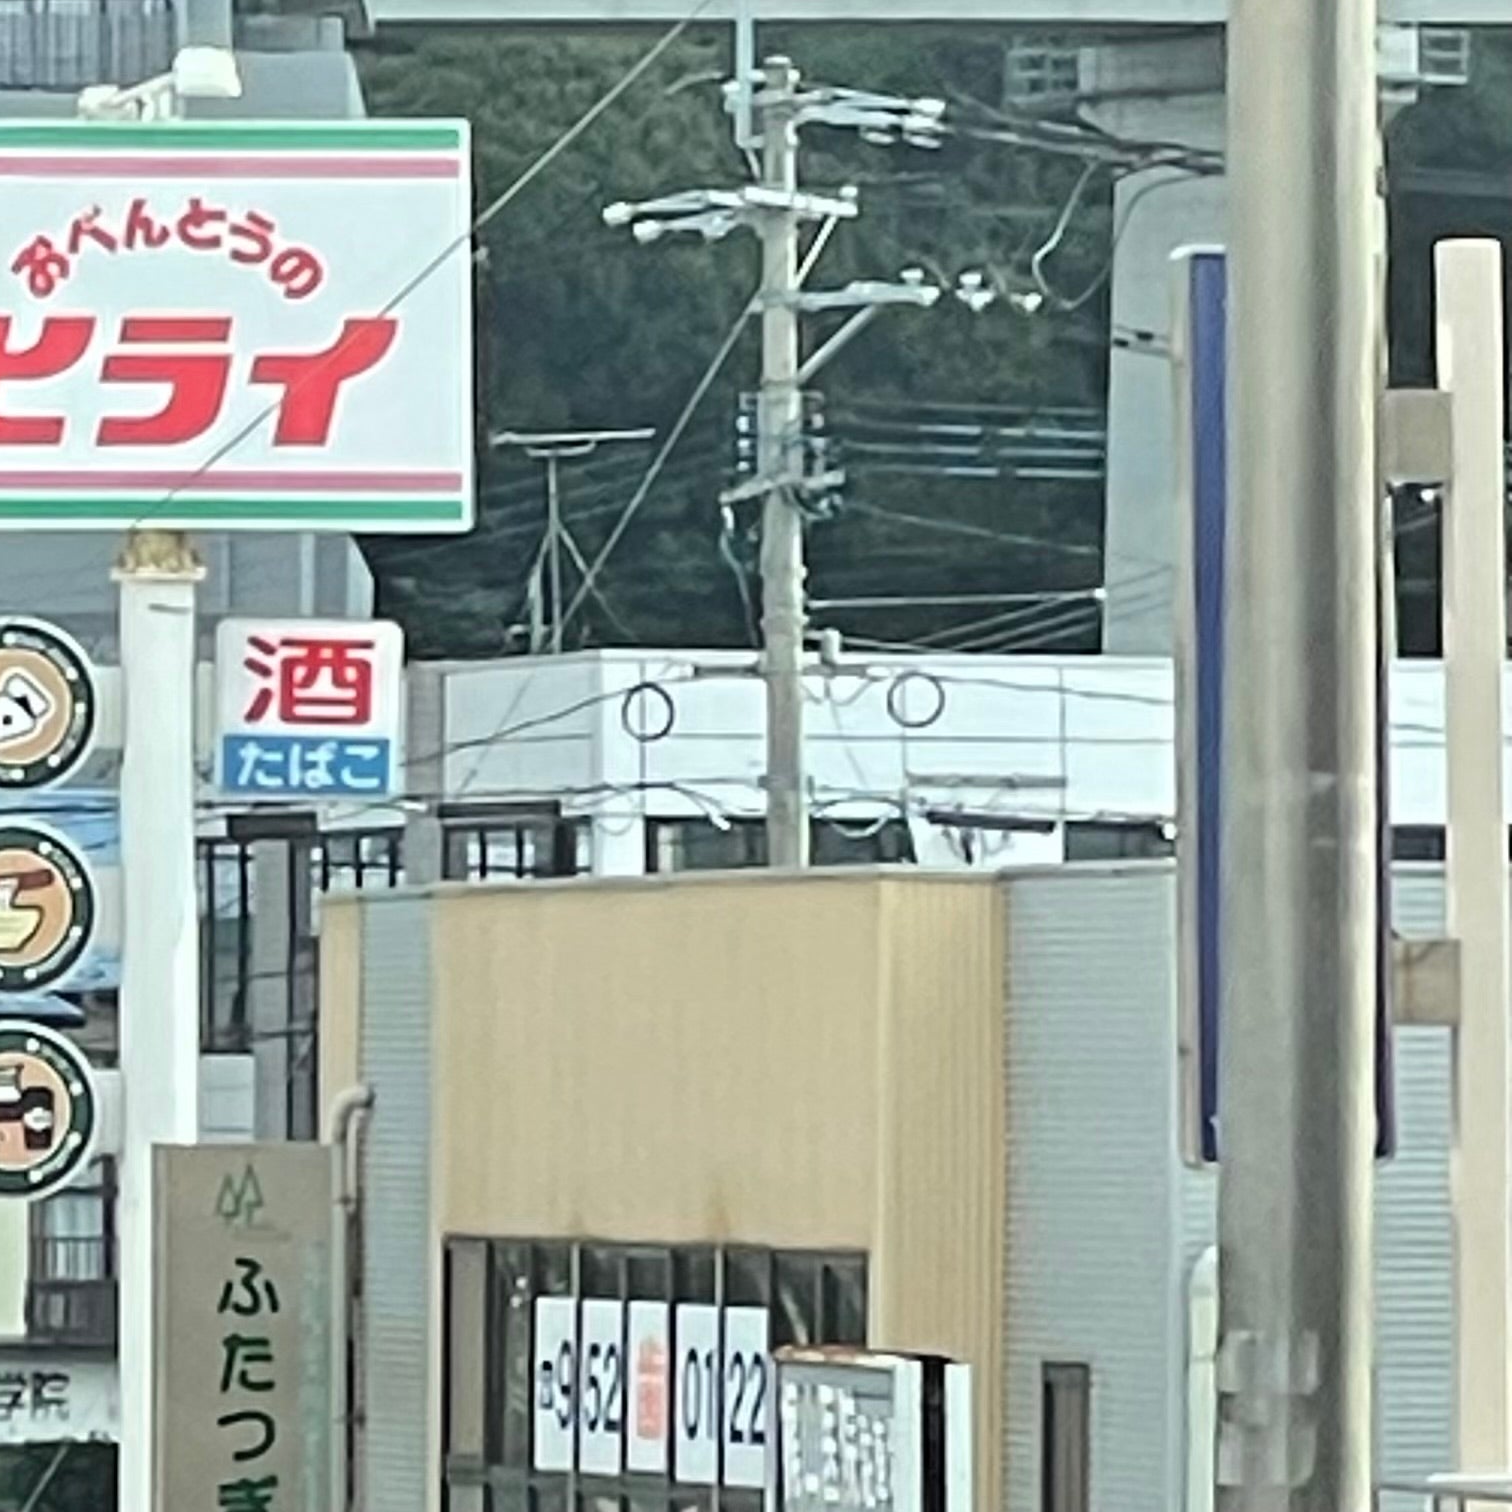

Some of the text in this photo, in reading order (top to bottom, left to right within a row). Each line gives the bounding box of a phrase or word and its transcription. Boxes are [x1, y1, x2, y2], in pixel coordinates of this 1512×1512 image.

[11, 197, 324, 300] おべんとうの
[243, 636, 375, 725] 酒
[238, 741, 381, 789] たばこ
